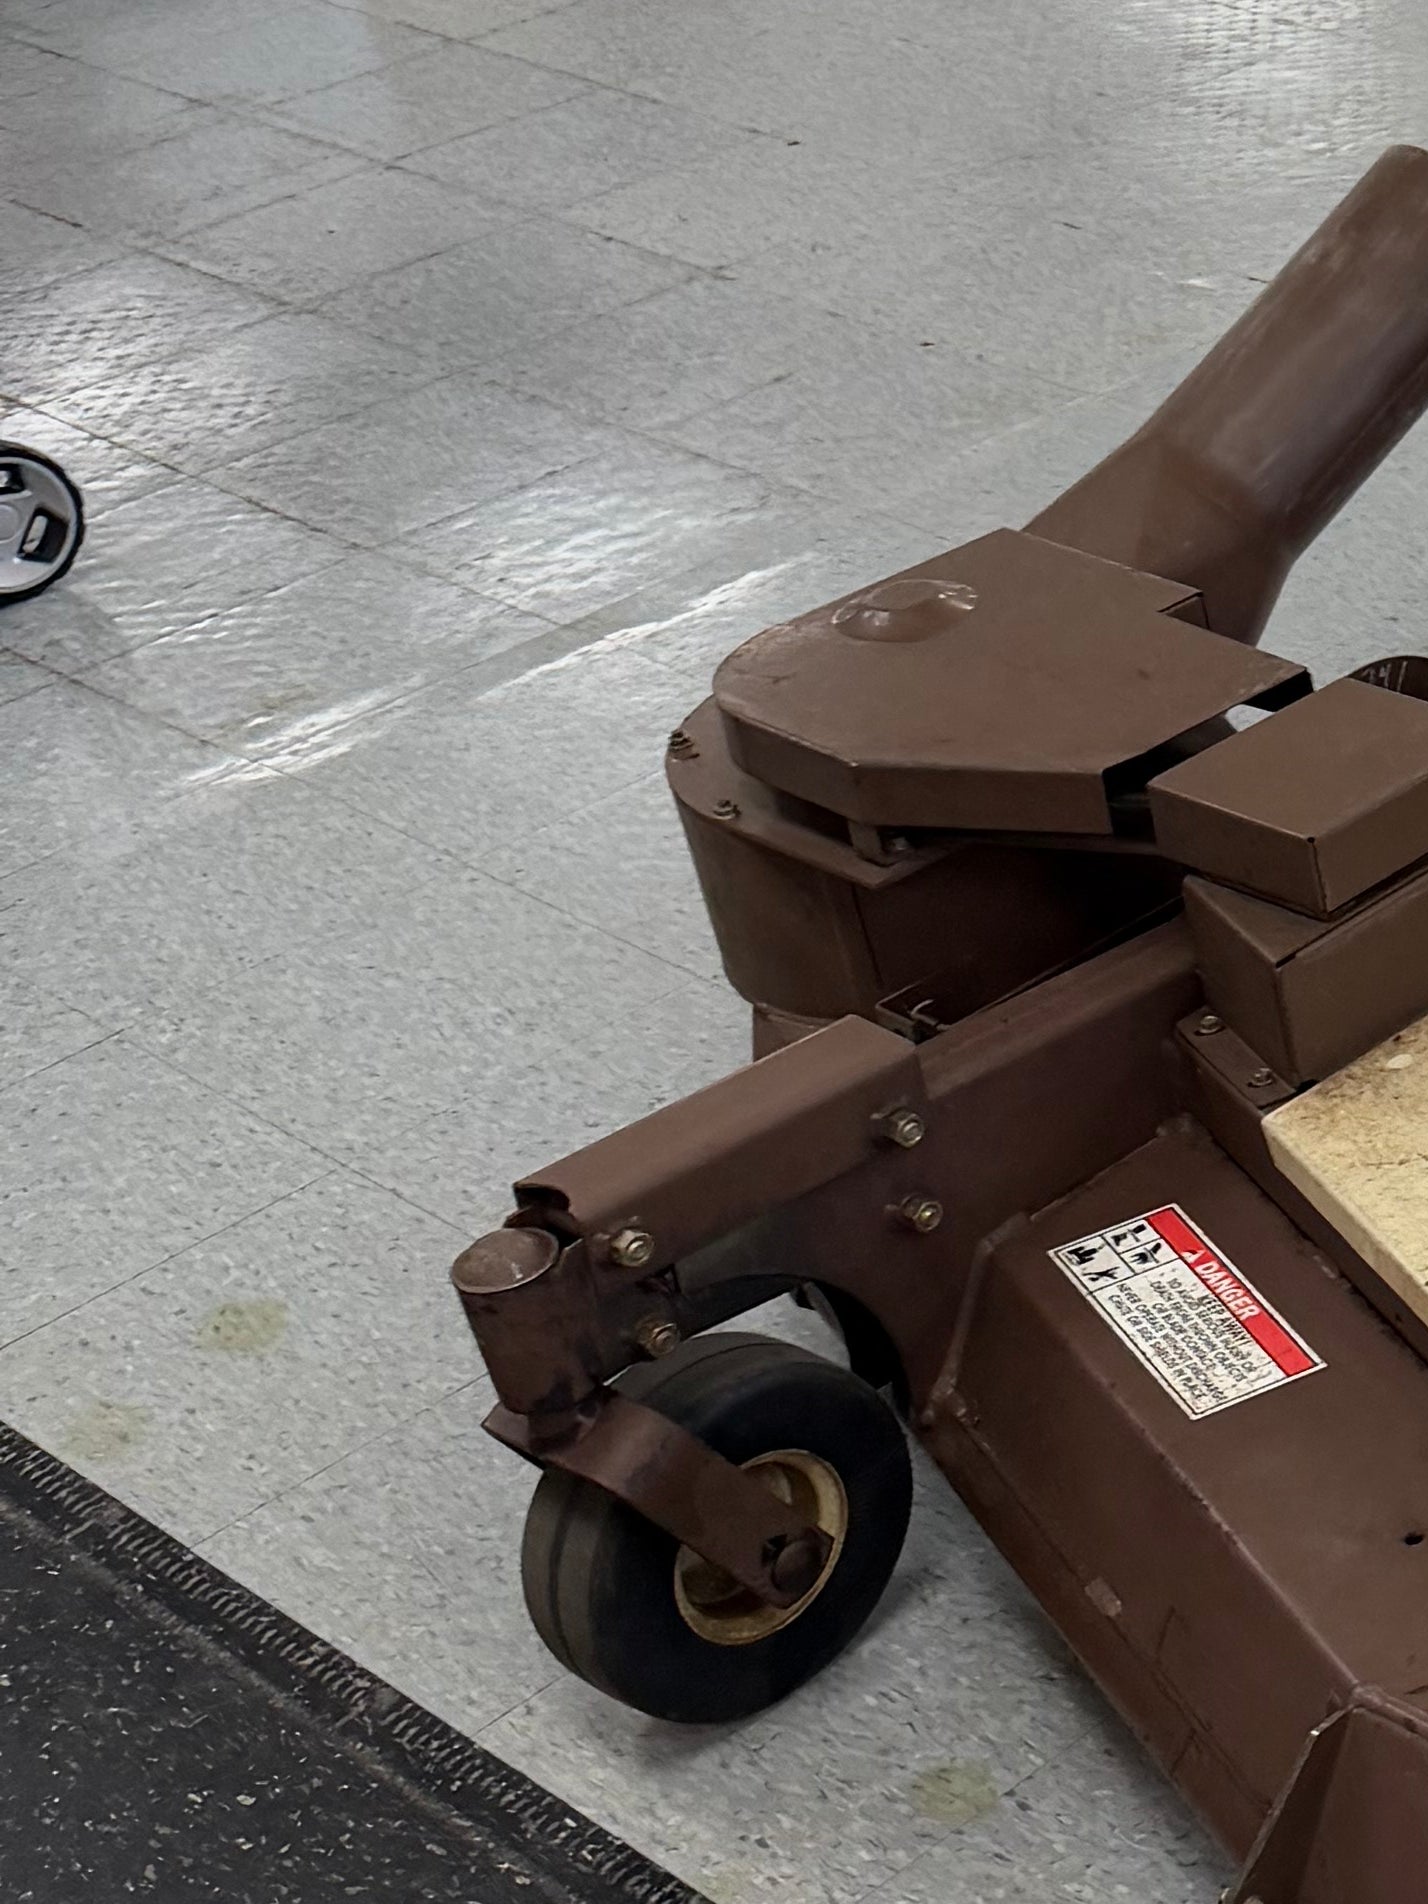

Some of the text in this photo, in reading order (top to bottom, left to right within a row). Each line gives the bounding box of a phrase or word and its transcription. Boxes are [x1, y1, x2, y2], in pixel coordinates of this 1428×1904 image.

[1114, 1282, 1141, 1305] NEVER
[1132, 1302, 1167, 1334] OPERATE
[1158, 1331, 1194, 1364] WITHOUT
[1149, 1301, 1168, 1315] OR
[1160, 1313, 1187, 1336] BLADE
[1164, 1277, 1259, 1374] TO AVOID SERIOUS INJURY OR
[1193, 1259, 1262, 1320] DANGER
[1196, 1293, 1253, 1346] KEEP AWAY!
[1106, 1293, 1134, 1316] CHUTE
[1124, 1314, 1144, 1328] OR
[1134, 1325, 1157, 1342] SIDE
[1147, 1340, 1180, 1369] SHIELDS
[1148, 1280, 1247, 1382] DEATH FROM THROWN OBJECTS
